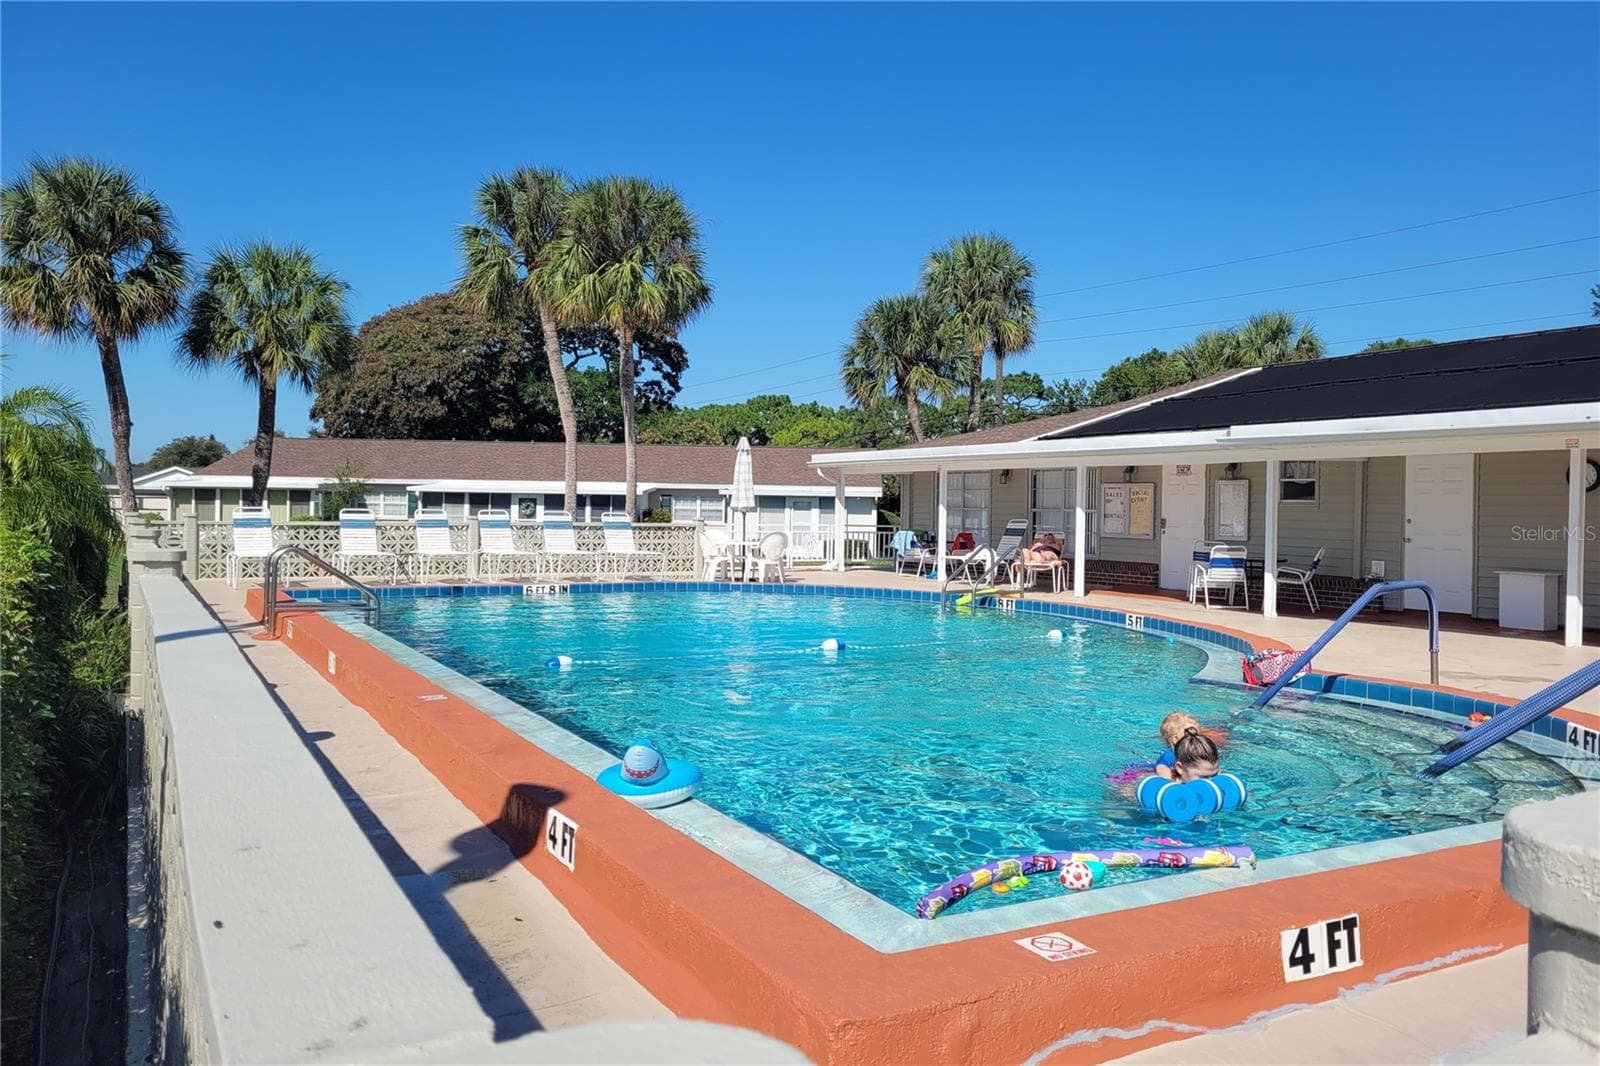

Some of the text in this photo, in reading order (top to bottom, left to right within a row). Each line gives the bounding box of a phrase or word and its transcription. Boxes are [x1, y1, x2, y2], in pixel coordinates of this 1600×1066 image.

[526, 584, 568, 596] 6 FT 8 IN
[1006, 599, 1014, 609] FT
[1135, 615, 1142, 629] FT
[1568, 726, 1597, 754] 4 FT
[548, 815, 576, 865] 4 FT
[1288, 915, 1358, 976] 4 FT
